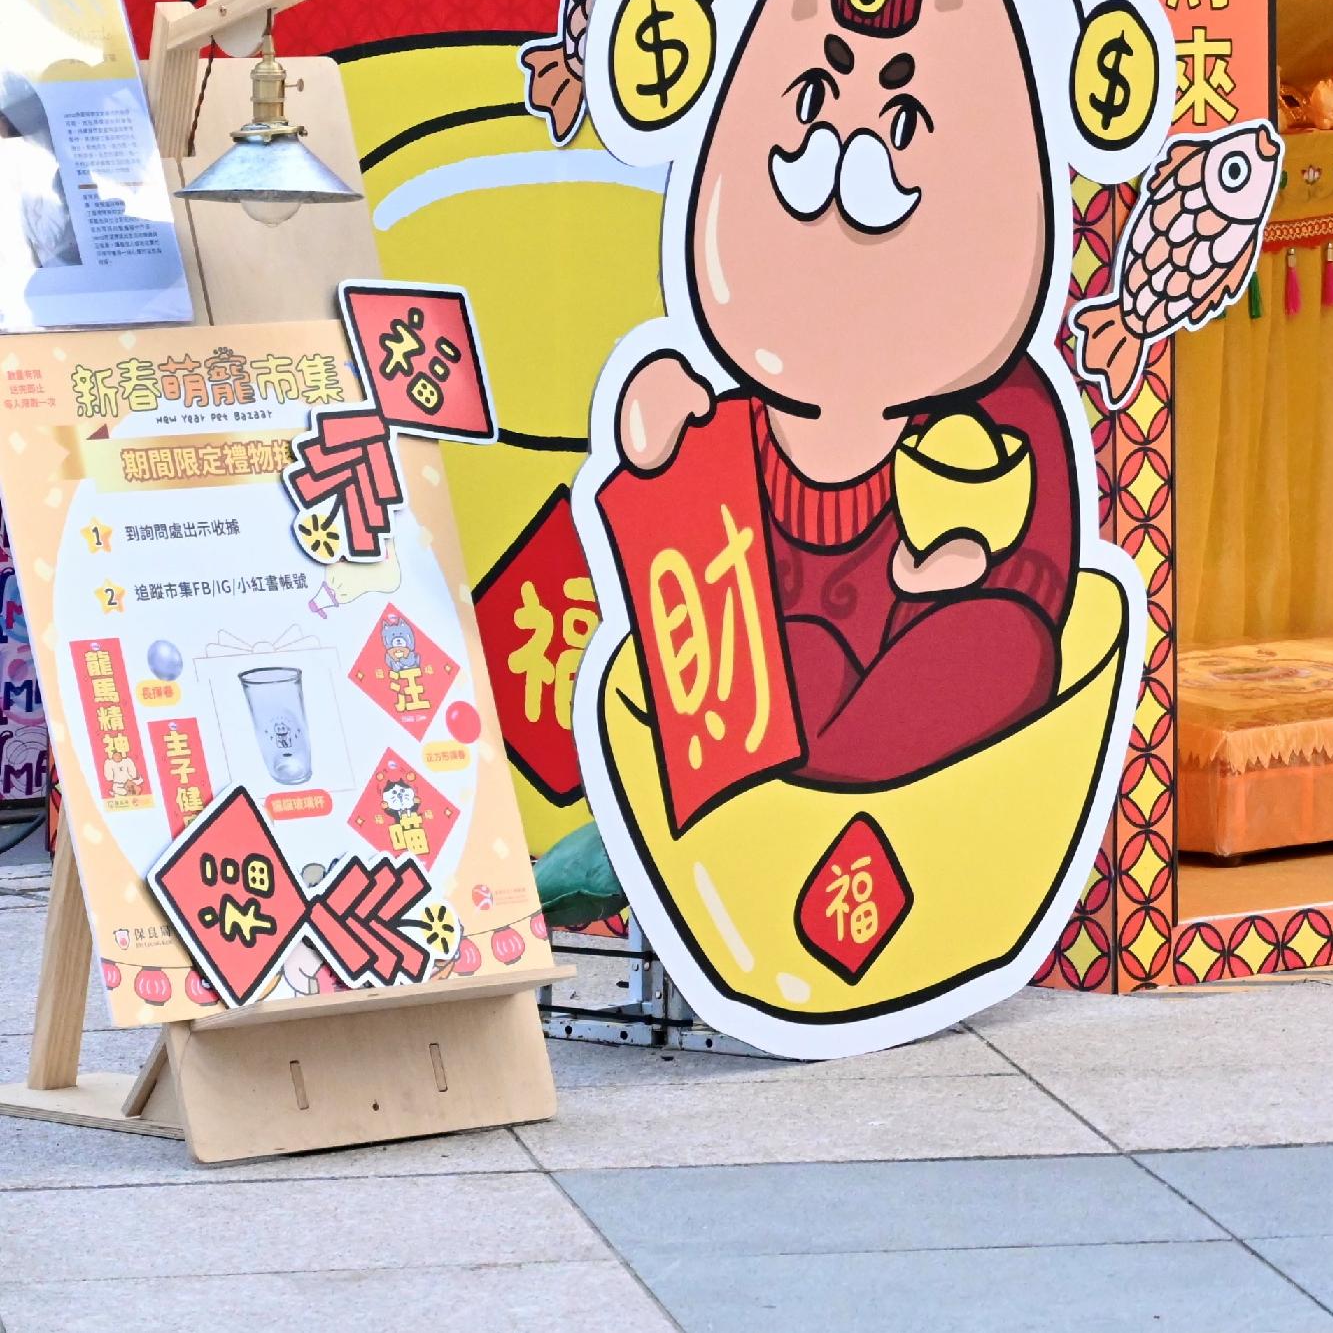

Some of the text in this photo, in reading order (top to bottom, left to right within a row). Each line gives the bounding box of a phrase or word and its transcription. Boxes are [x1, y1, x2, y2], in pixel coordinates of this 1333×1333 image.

[71, 351, 344, 417] 新春萌寵市集
[379, 307, 462, 416] 福
[156, 409, 274, 425] New Year Pet Bazaar
[91, 517, 241, 547] 1 到詢問處出示收據
[104, 587, 117, 607] 2
[509, 578, 598, 724] 福
[645, 501, 772, 770] 財
[84, 650, 131, 758] 龍馬精神
[389, 668, 431, 713] 汪
[388, 811, 431, 856] 喵
[197, 851, 278, 949] 福
[824, 862, 881, 946] 福
